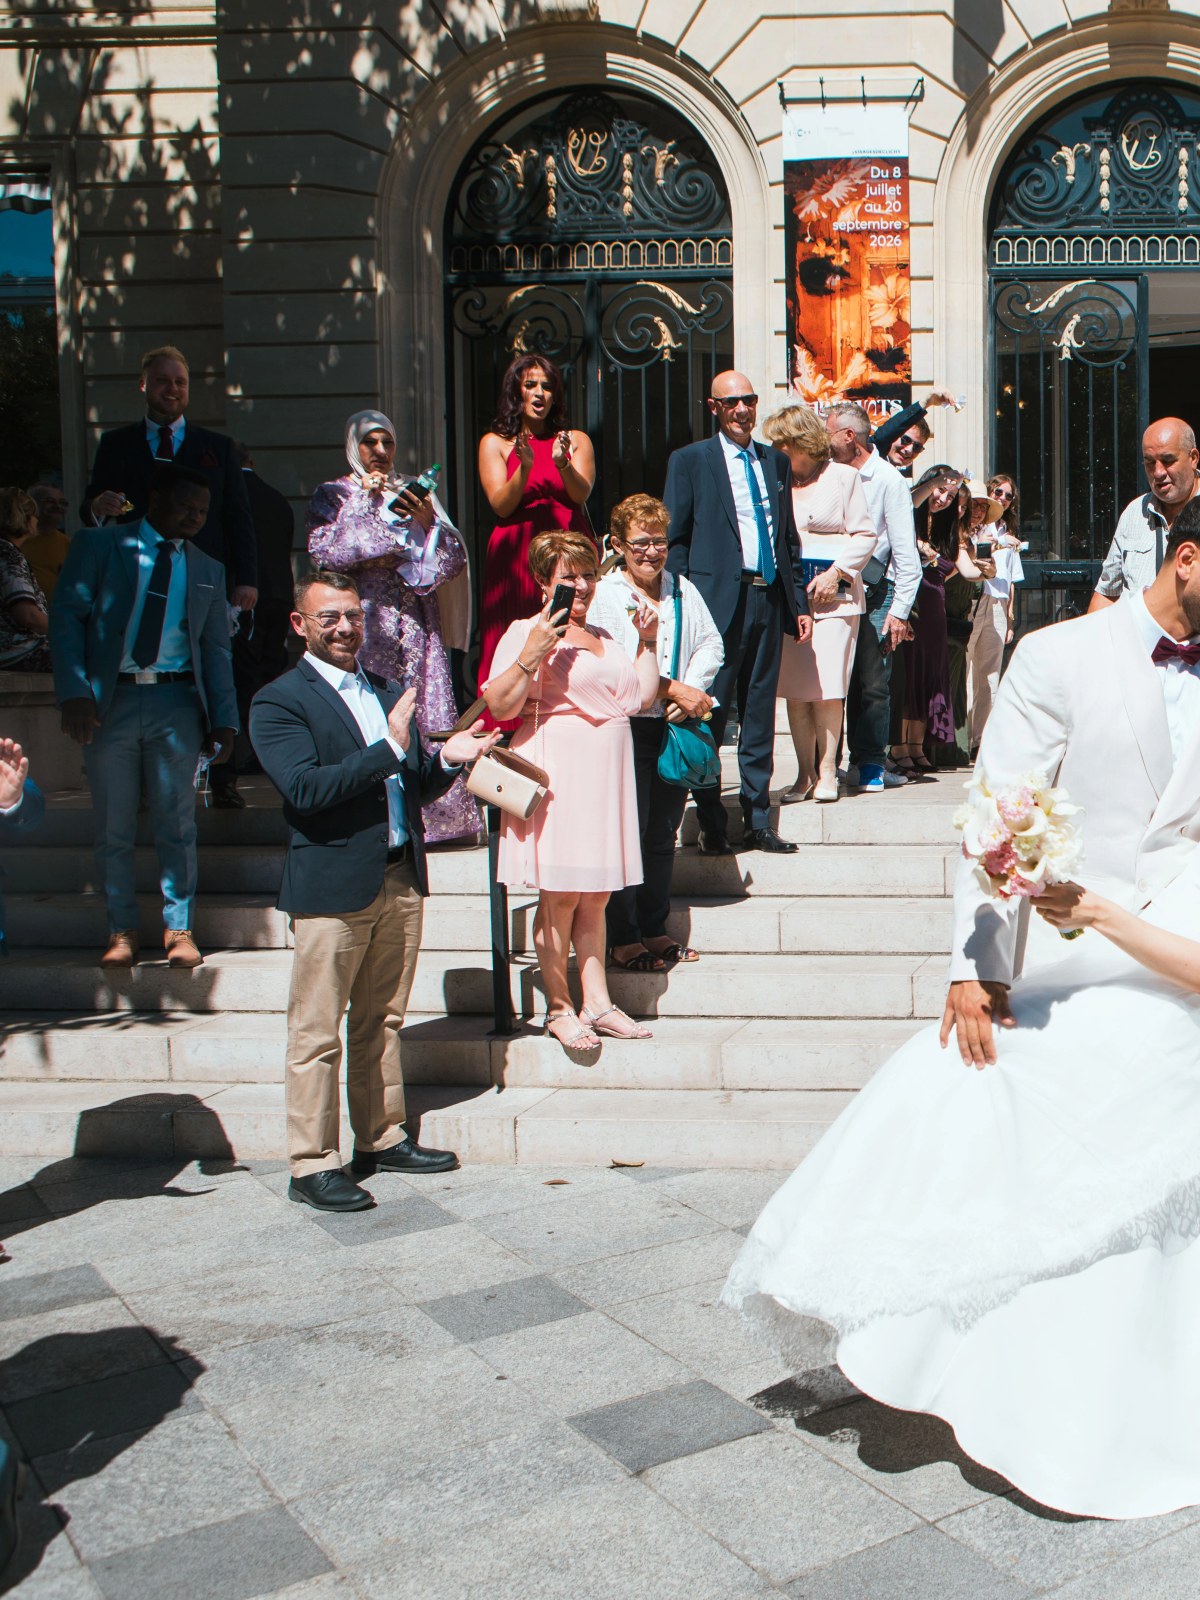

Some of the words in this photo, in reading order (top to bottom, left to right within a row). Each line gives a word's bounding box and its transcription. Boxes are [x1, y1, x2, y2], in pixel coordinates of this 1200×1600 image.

[870, 166, 889, 179] Du
[892, 166, 902, 179] 8
[865, 183, 902, 198] juillet
[864, 203, 882, 213] au
[885, 200, 902, 213] 20
[832, 218, 902, 232] septembre
[869, 234, 902, 247] 2026
